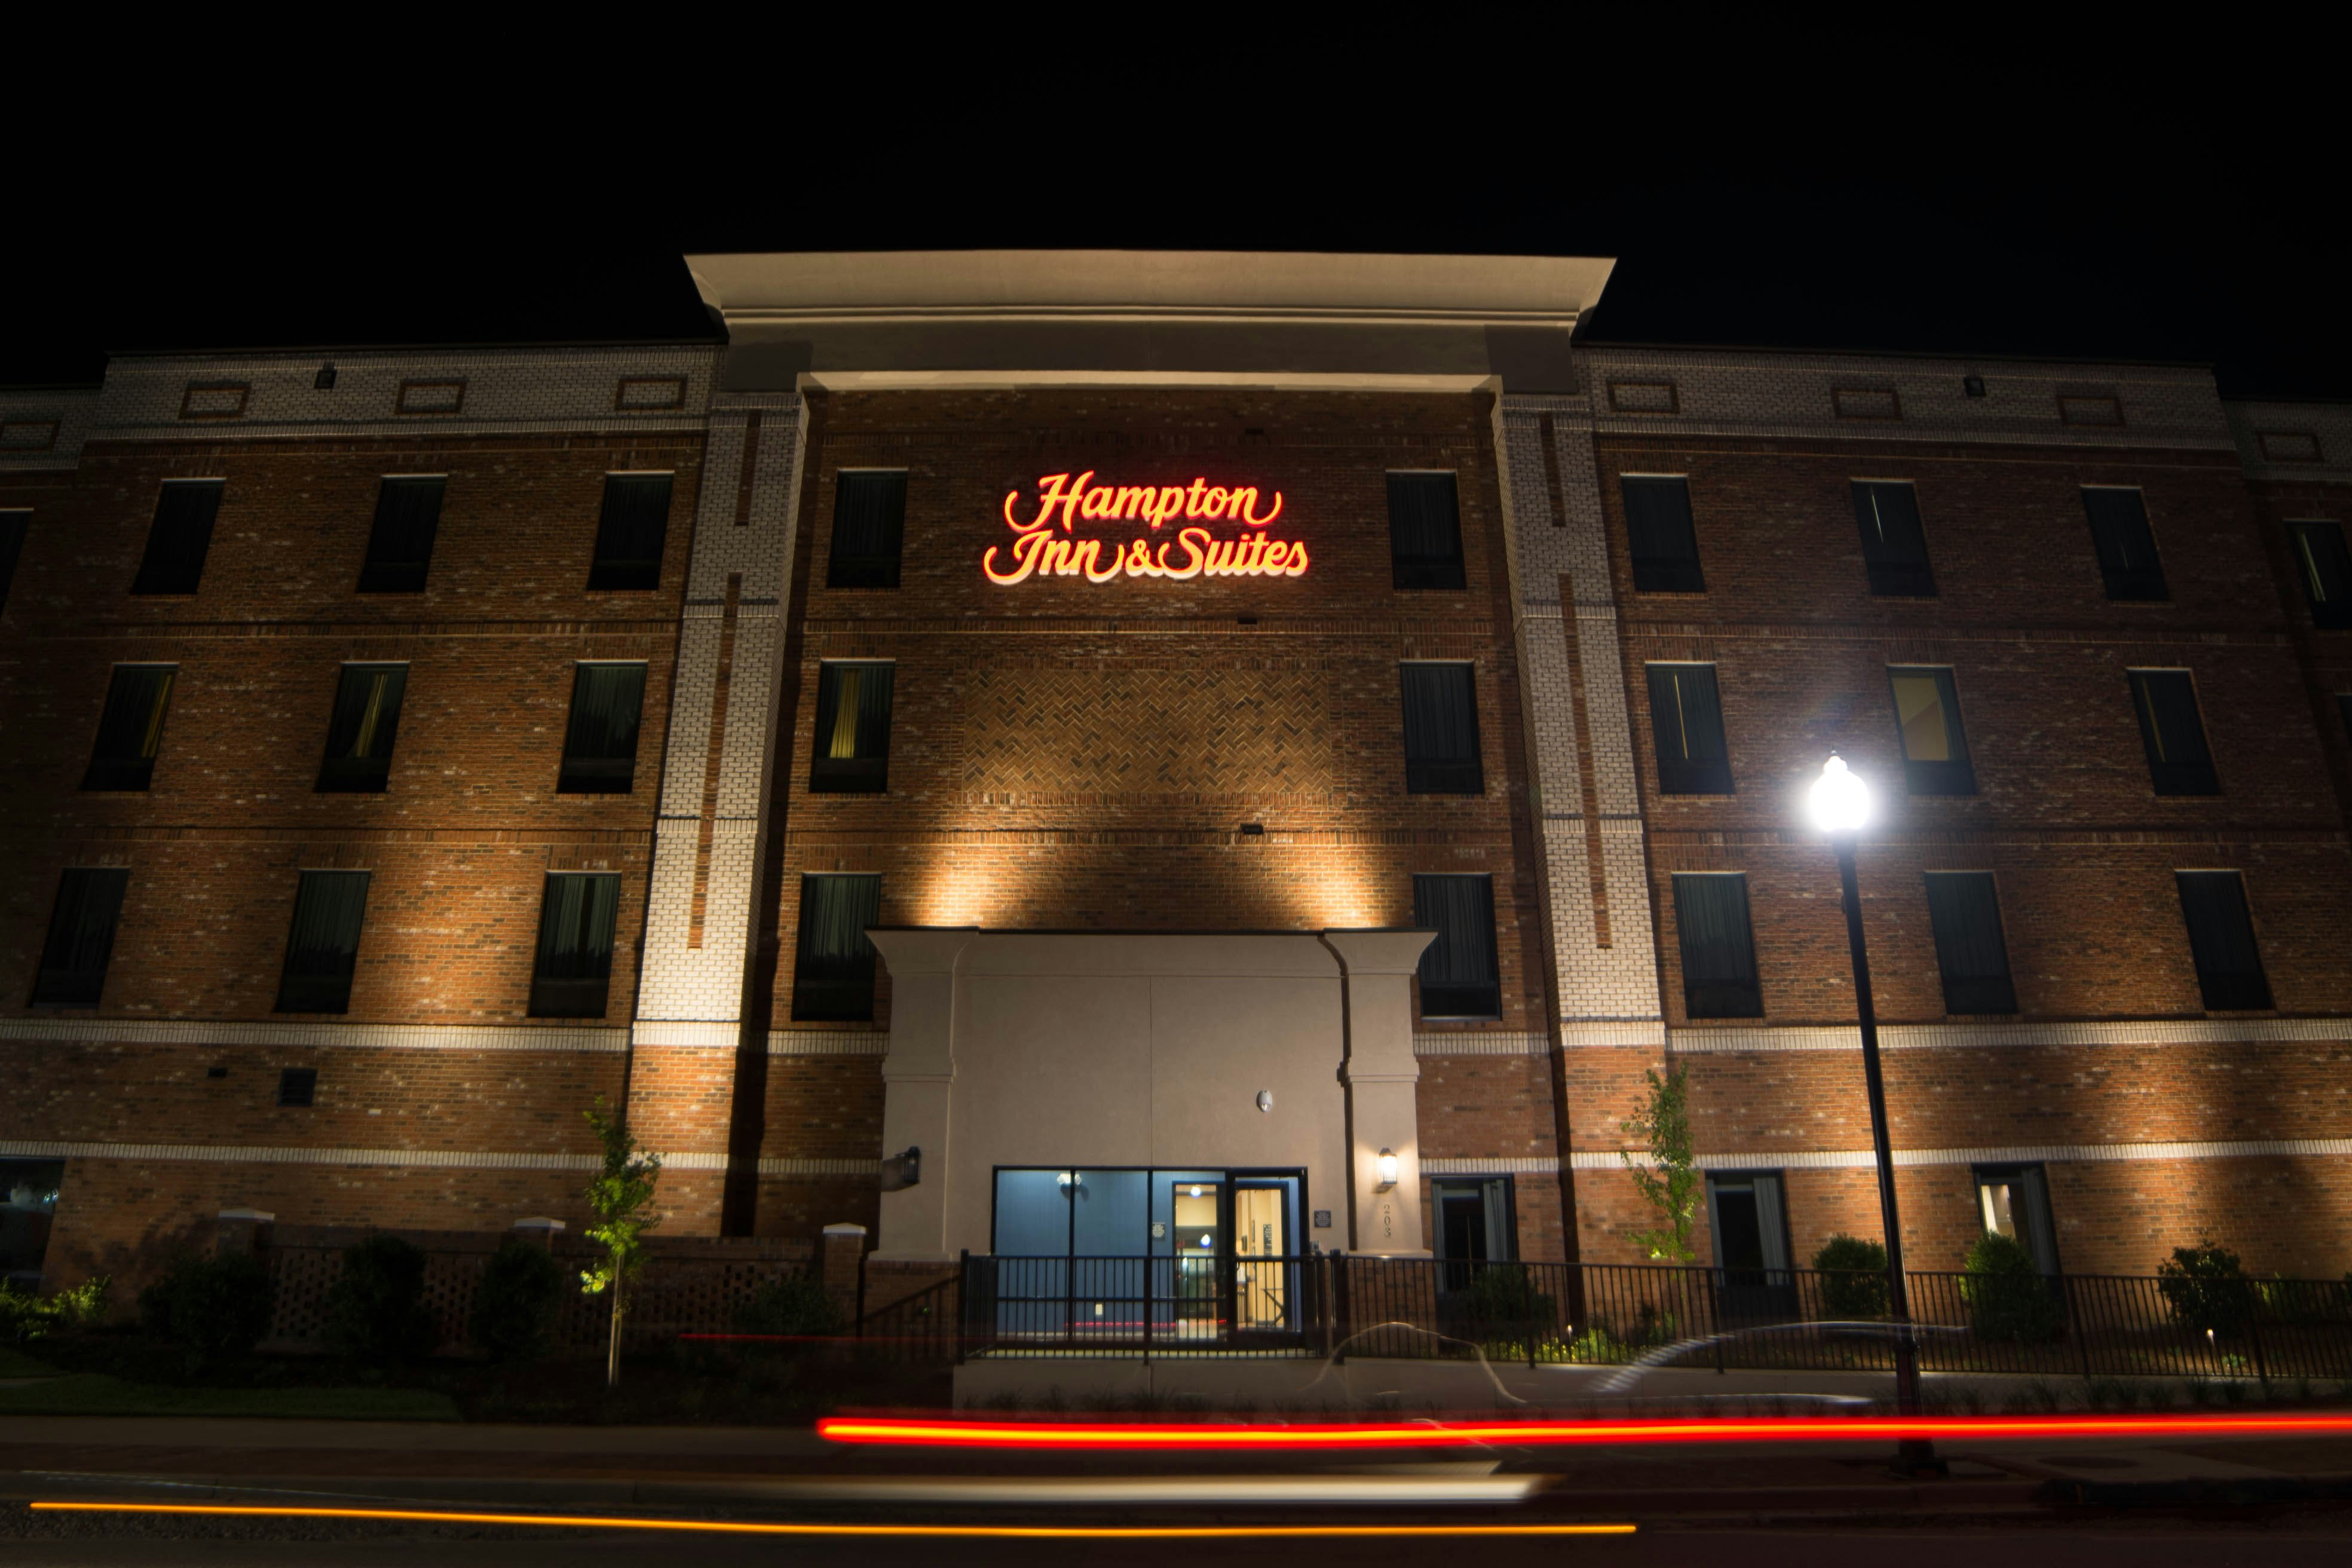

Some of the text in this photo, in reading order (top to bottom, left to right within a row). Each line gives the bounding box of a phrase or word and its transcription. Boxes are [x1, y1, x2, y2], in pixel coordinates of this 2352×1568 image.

[1004, 470, 1282, 534] Hampton
[983, 527, 1309, 584] Inn & Suites
